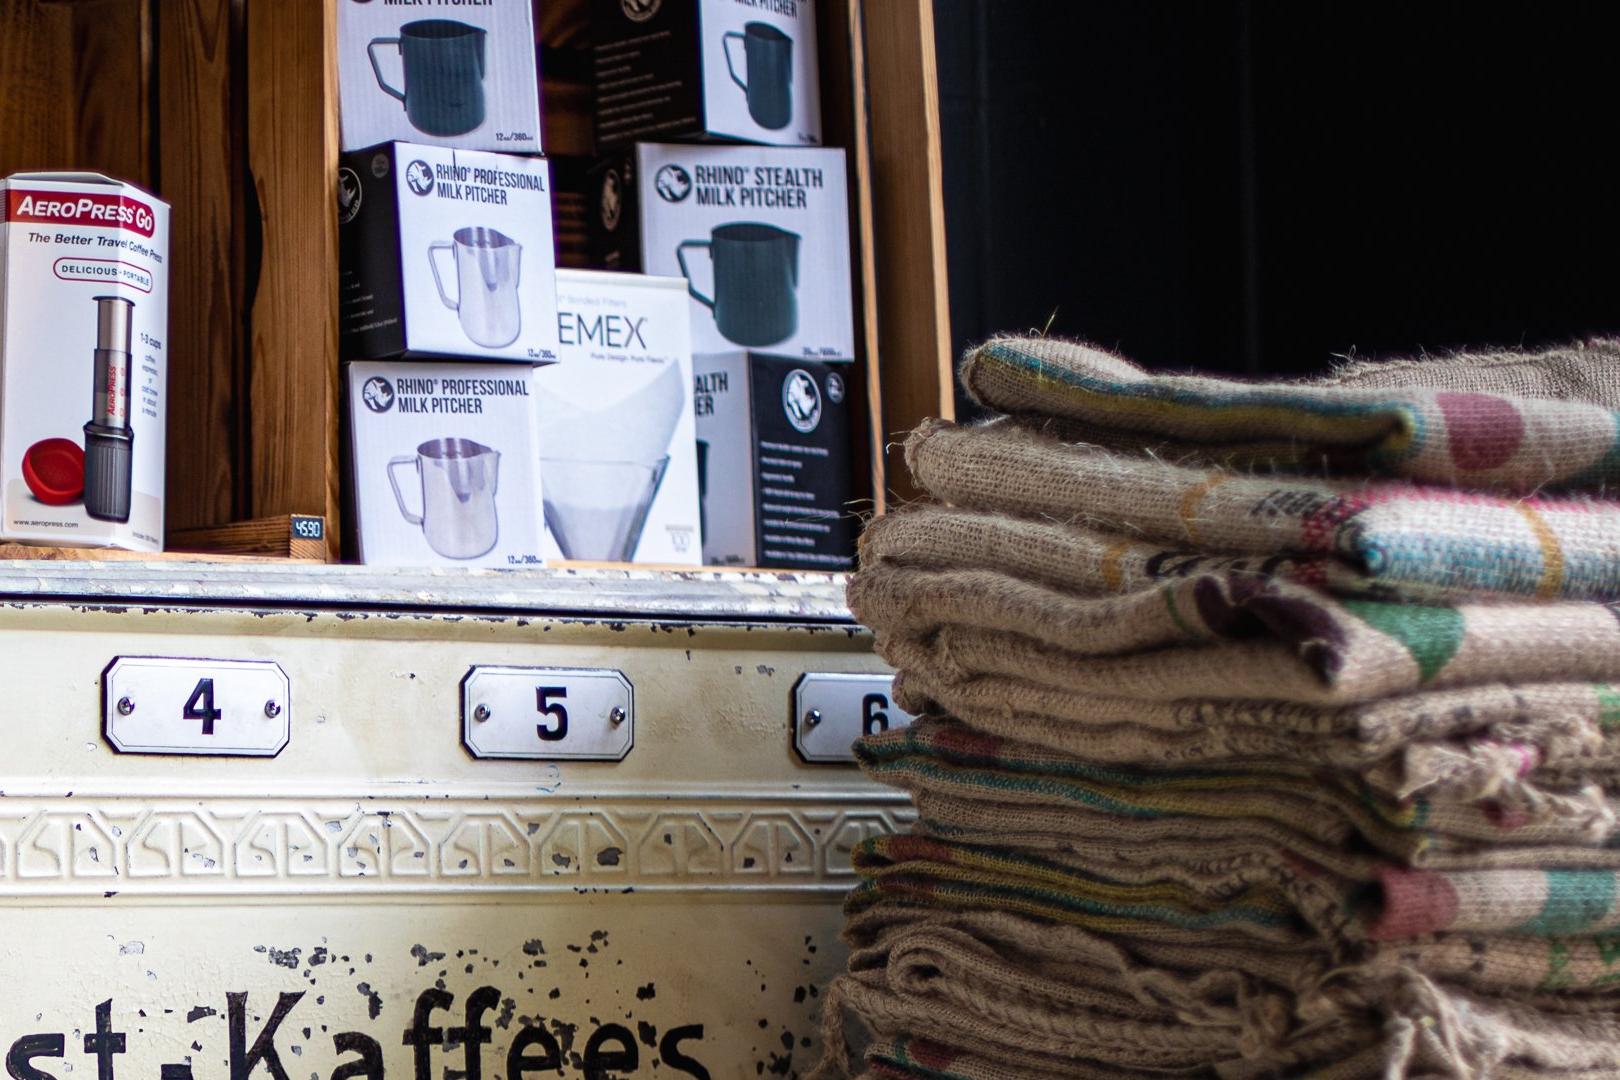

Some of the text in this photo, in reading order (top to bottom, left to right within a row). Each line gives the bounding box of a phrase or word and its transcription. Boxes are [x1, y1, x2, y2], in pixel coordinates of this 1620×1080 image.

[473, 167, 545, 192] PROFESSIONAL
[753, 165, 824, 189] STEALTH
[437, 182, 508, 206] MILK PITCHER
[696, 186, 808, 209] MILK PITCHER
[28, 231, 163, 264] The Better Travel Coffee Press
[61, 264, 150, 287] DELICIOUS PORTABLE
[441, 379, 530, 396] PROFESSIONAL
[398, 397, 483, 414] MILK PITCHER
[12, 518, 79, 530] www.aeropress.com
[181, 677, 223, 736] 4
[534, 685, 570, 743] 5
[862, 692, 889, 736] 6
